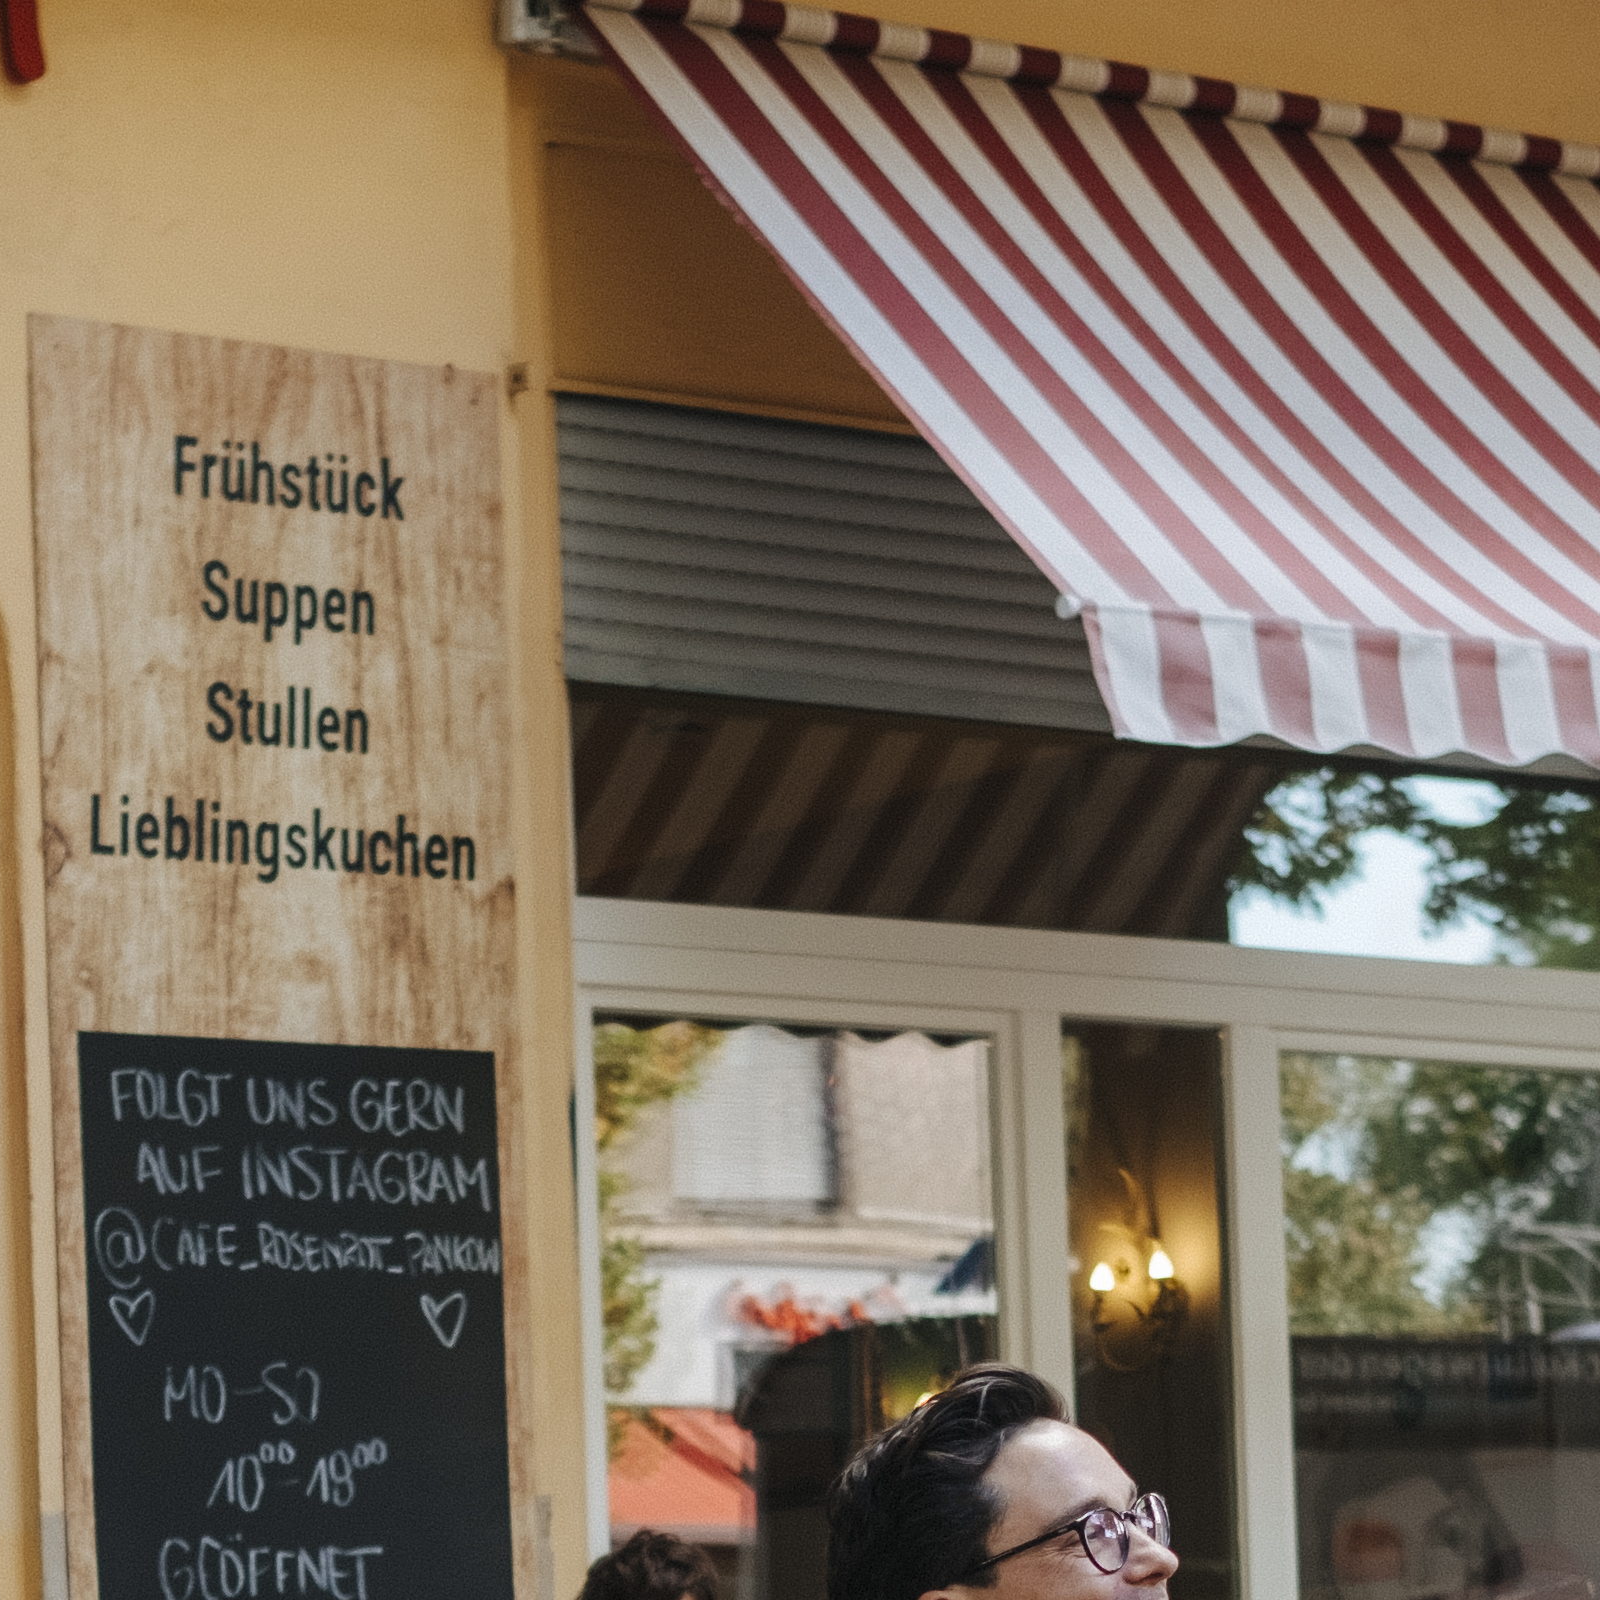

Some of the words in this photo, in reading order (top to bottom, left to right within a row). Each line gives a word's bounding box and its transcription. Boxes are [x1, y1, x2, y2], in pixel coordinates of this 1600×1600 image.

[172, 434, 405, 520] Frühstück
[201, 560, 375, 645] Suppen
[205, 682, 369, 755] Stullen
[89, 793, 476, 884] Lieblingskuchen
[111, 1068, 233, 1127] FOLGT
[246, 1077, 338, 1130] UNS
[350, 1078, 465, 1137] GERN
[136, 1142, 223, 1195] AUF
[240, 1143, 492, 1212] INSTAGRAM
